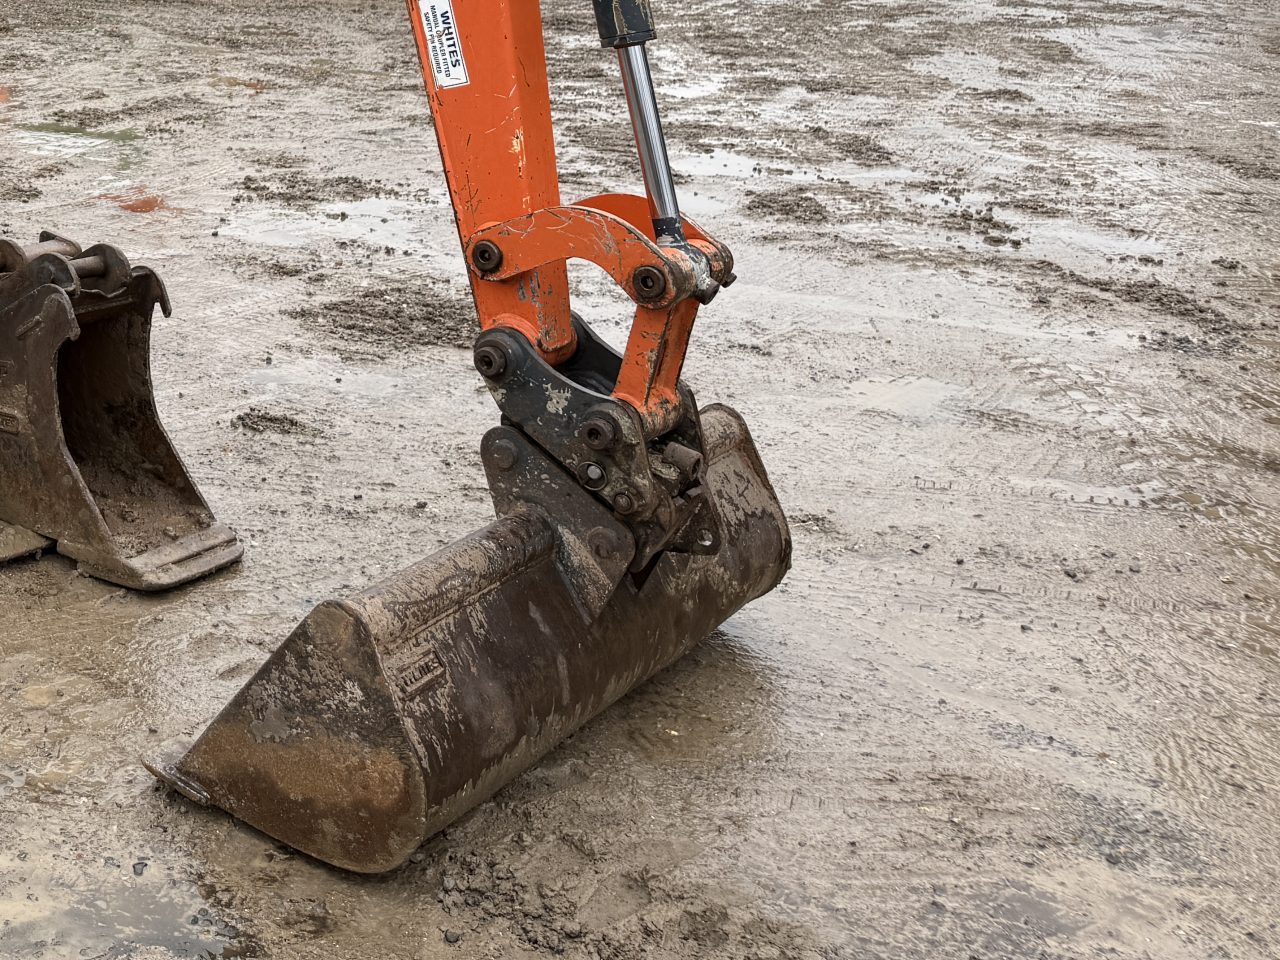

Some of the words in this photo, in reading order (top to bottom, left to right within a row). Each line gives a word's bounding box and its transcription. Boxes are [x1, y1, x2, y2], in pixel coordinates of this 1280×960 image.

[424, 11, 433, 33] SAFETY
[431, 45, 442, 74] REQUIRED
[430, 5, 439, 29] MANUAL
[442, 58, 451, 78] FITTED
[440, 10, 460, 68] WHITES
